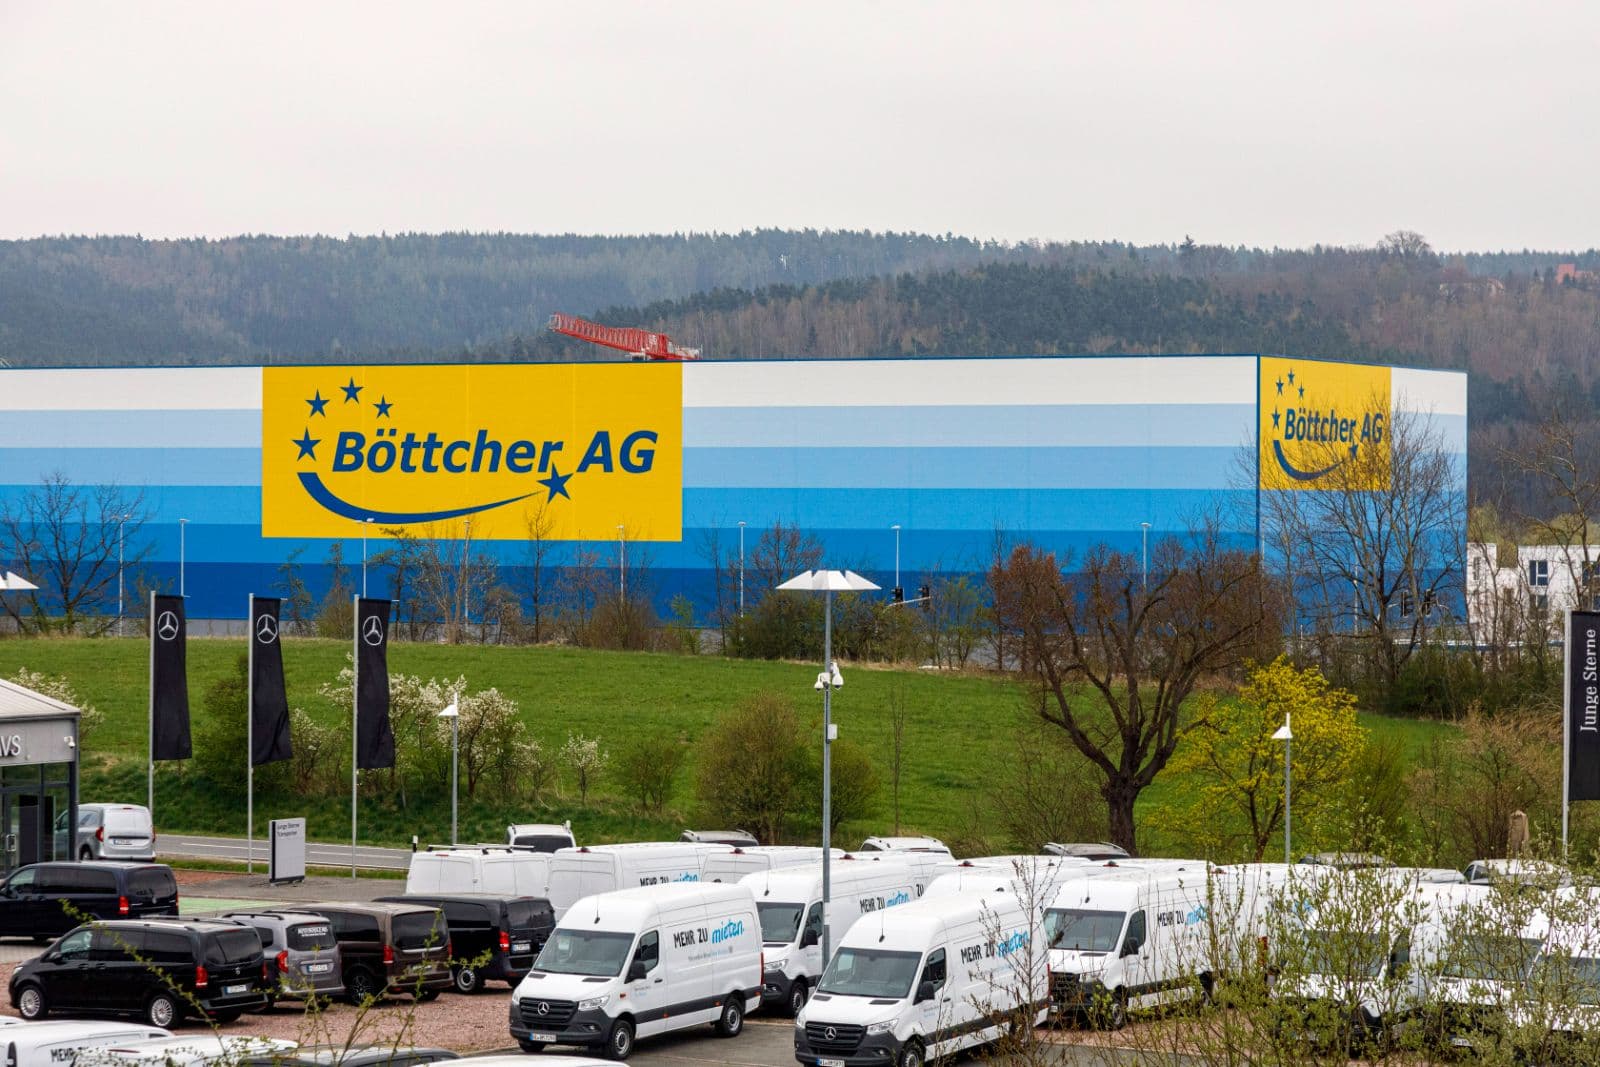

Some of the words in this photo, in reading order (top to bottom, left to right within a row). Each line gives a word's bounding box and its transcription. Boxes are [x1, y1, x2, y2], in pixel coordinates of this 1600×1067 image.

[1285, 407, 1357, 443] Böttcher
[1360, 412, 1384, 444] AG
[332, 428, 563, 473] Böttcher
[576, 430, 658, 474] AG
[1583, 629, 1598, 681] Sterne
[1580, 686, 1599, 732] Junge
[0, 735, 21, 756] VS
[859, 898, 876, 914] MEHR
[876, 896, 886, 910] ZU
[1175, 910, 1184, 925] ZU
[673, 930, 695, 949] MEHR
[697, 928, 708, 943] ZU
[960, 944, 982, 965] MEHR
[983, 941, 995, 958] ZU
